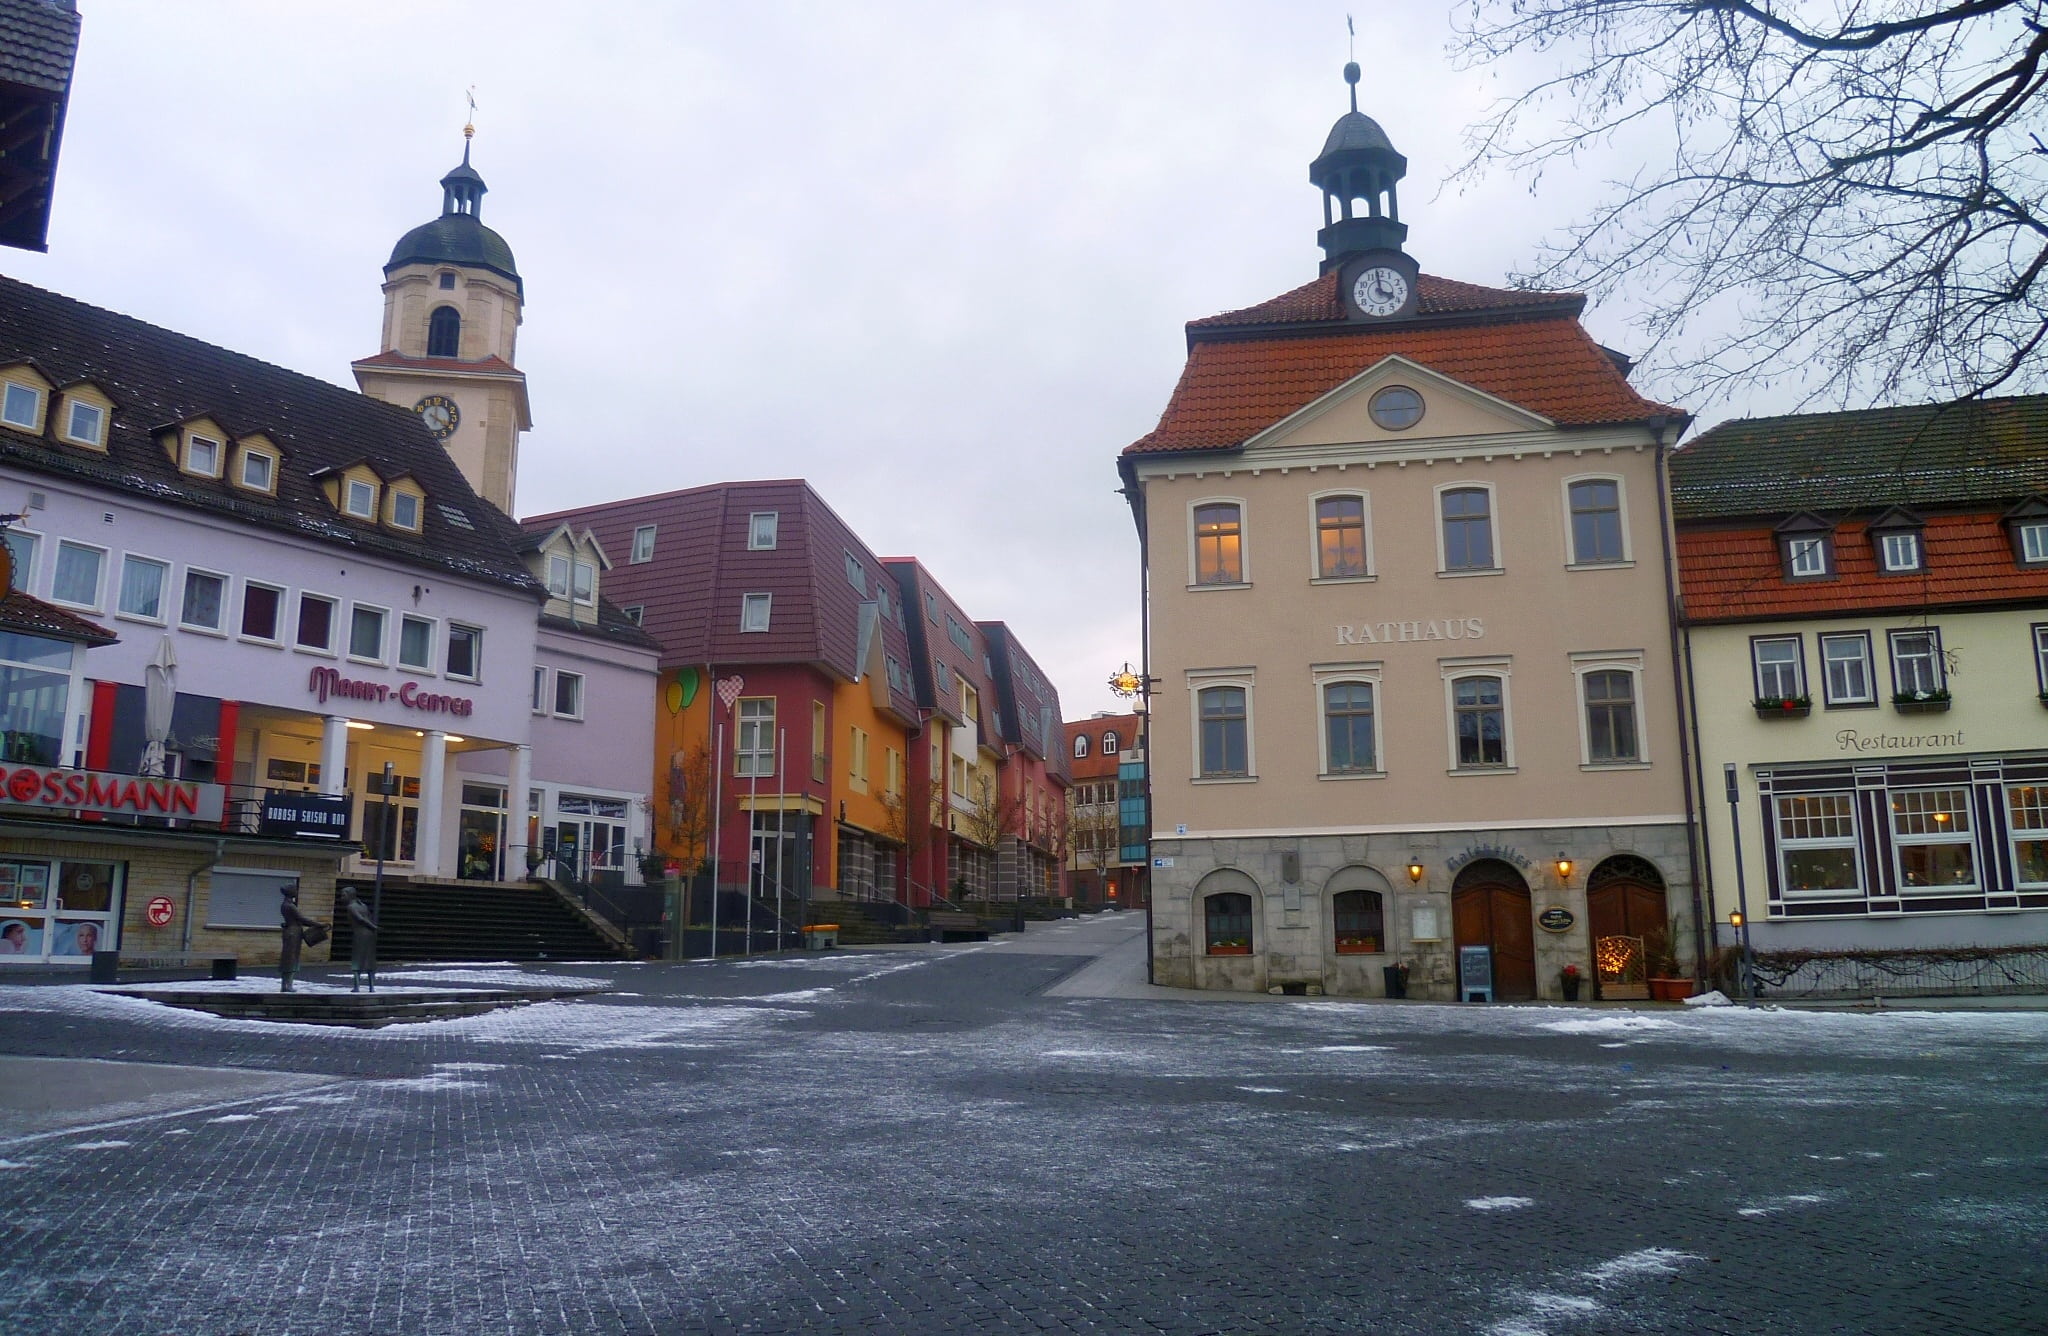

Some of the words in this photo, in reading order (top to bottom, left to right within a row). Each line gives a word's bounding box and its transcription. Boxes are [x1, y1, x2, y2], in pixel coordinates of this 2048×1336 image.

[1397, 287, 1403, 295] 3
[1335, 618, 1484, 645] RATHAUS
[1835, 729, 1966, 752] Restaurant
